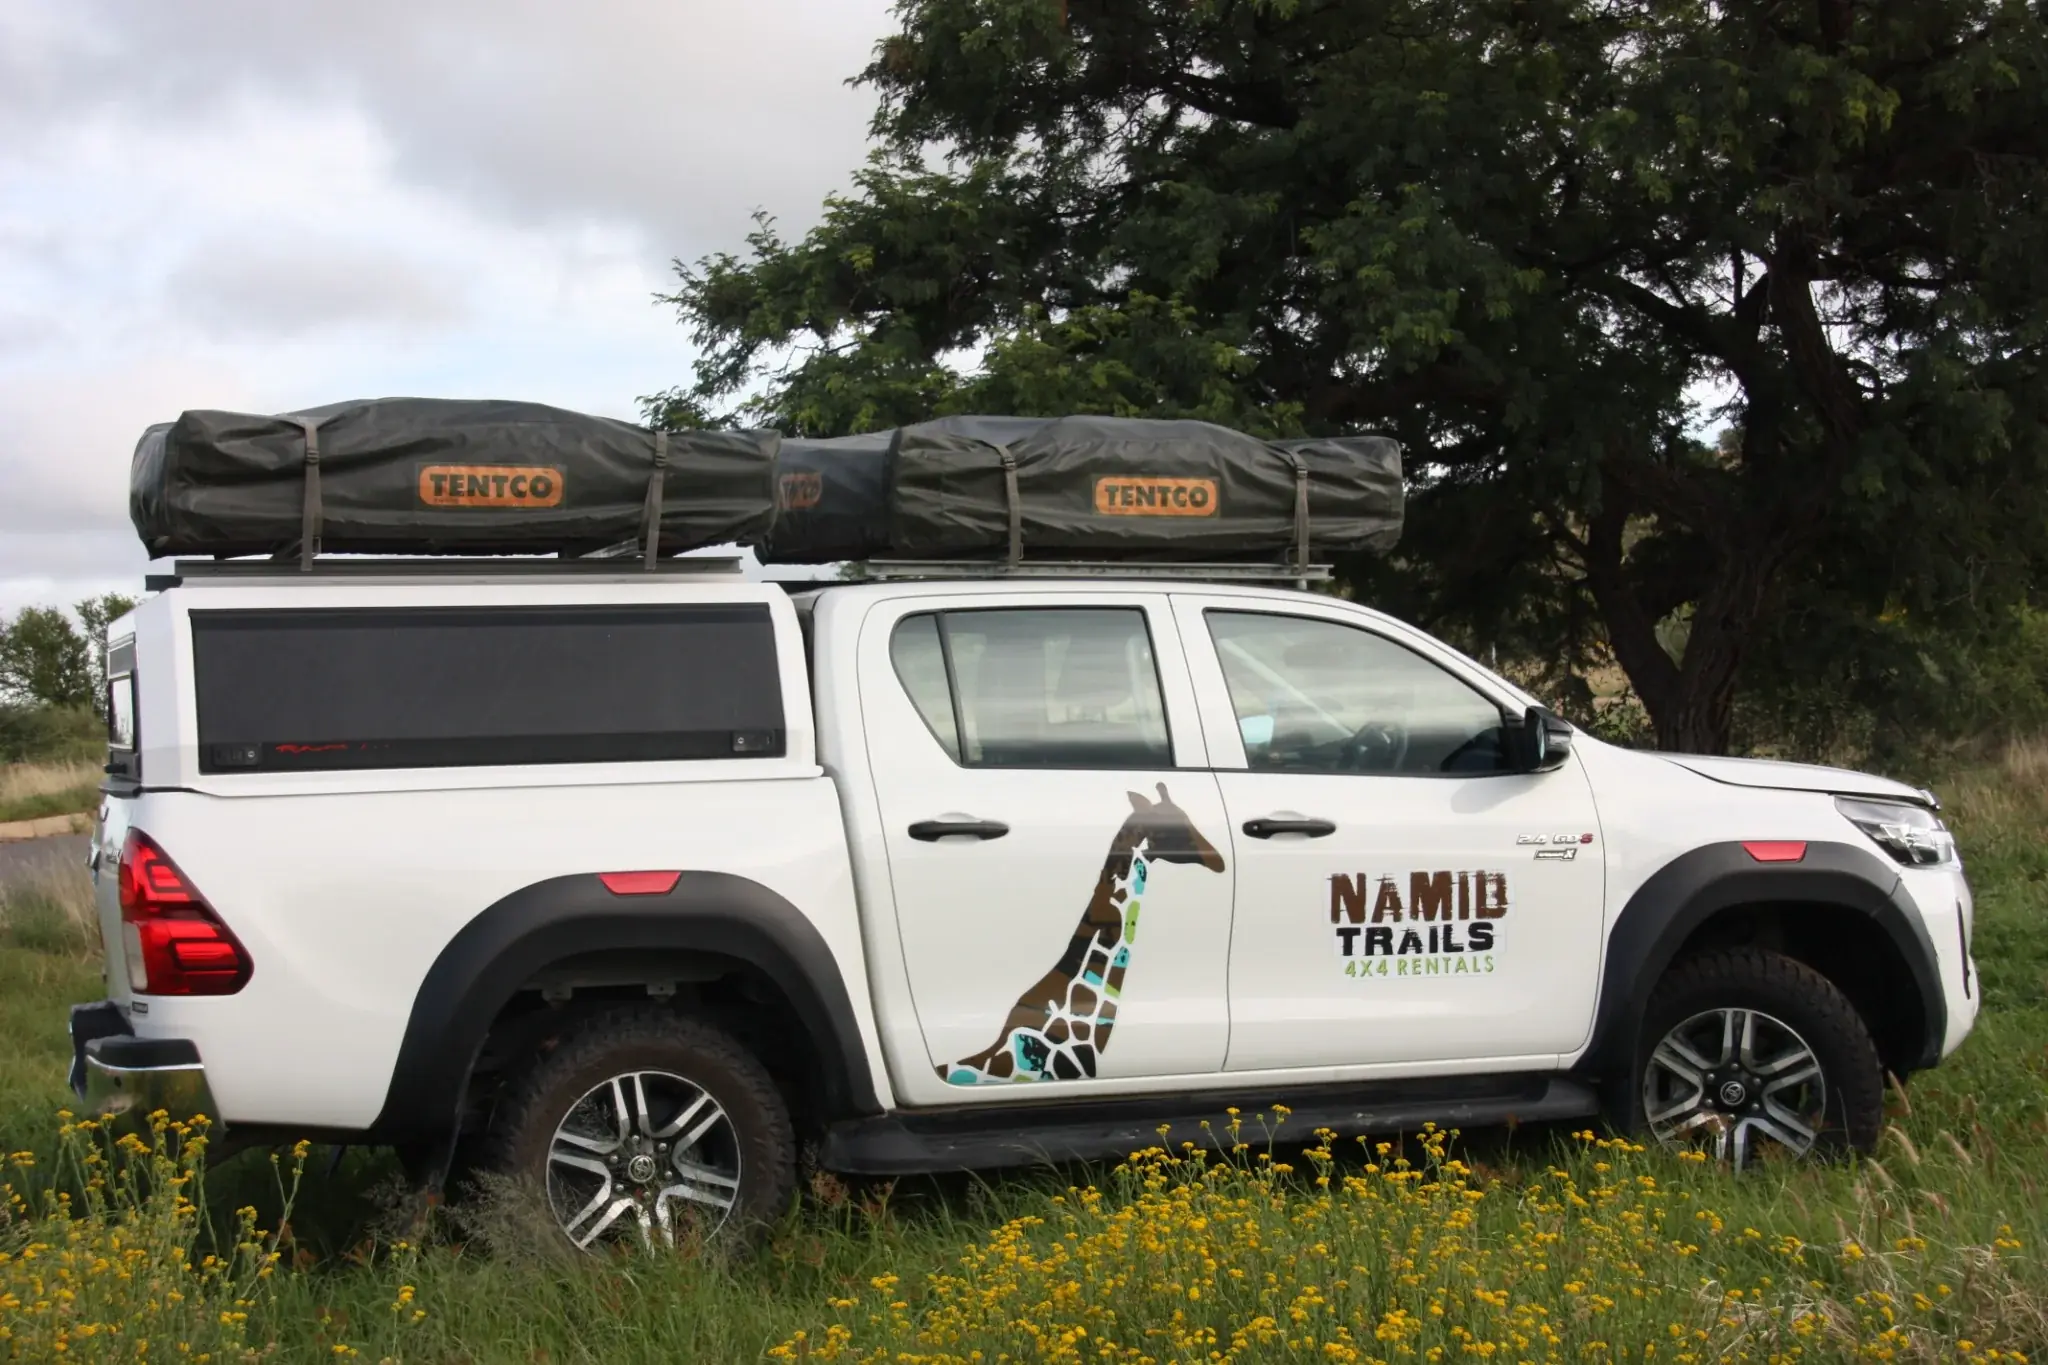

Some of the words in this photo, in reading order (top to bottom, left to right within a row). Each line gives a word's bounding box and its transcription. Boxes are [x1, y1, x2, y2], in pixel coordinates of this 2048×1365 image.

[429, 474, 553, 499] TENTCO
[1106, 485, 1209, 508] TENTCO
[1328, 870, 1508, 924] NAMIB
[1336, 922, 1494, 956] TRAILS
[1344, 959, 1388, 978] 4X4
[1397, 954, 1494, 976] RENTALS
